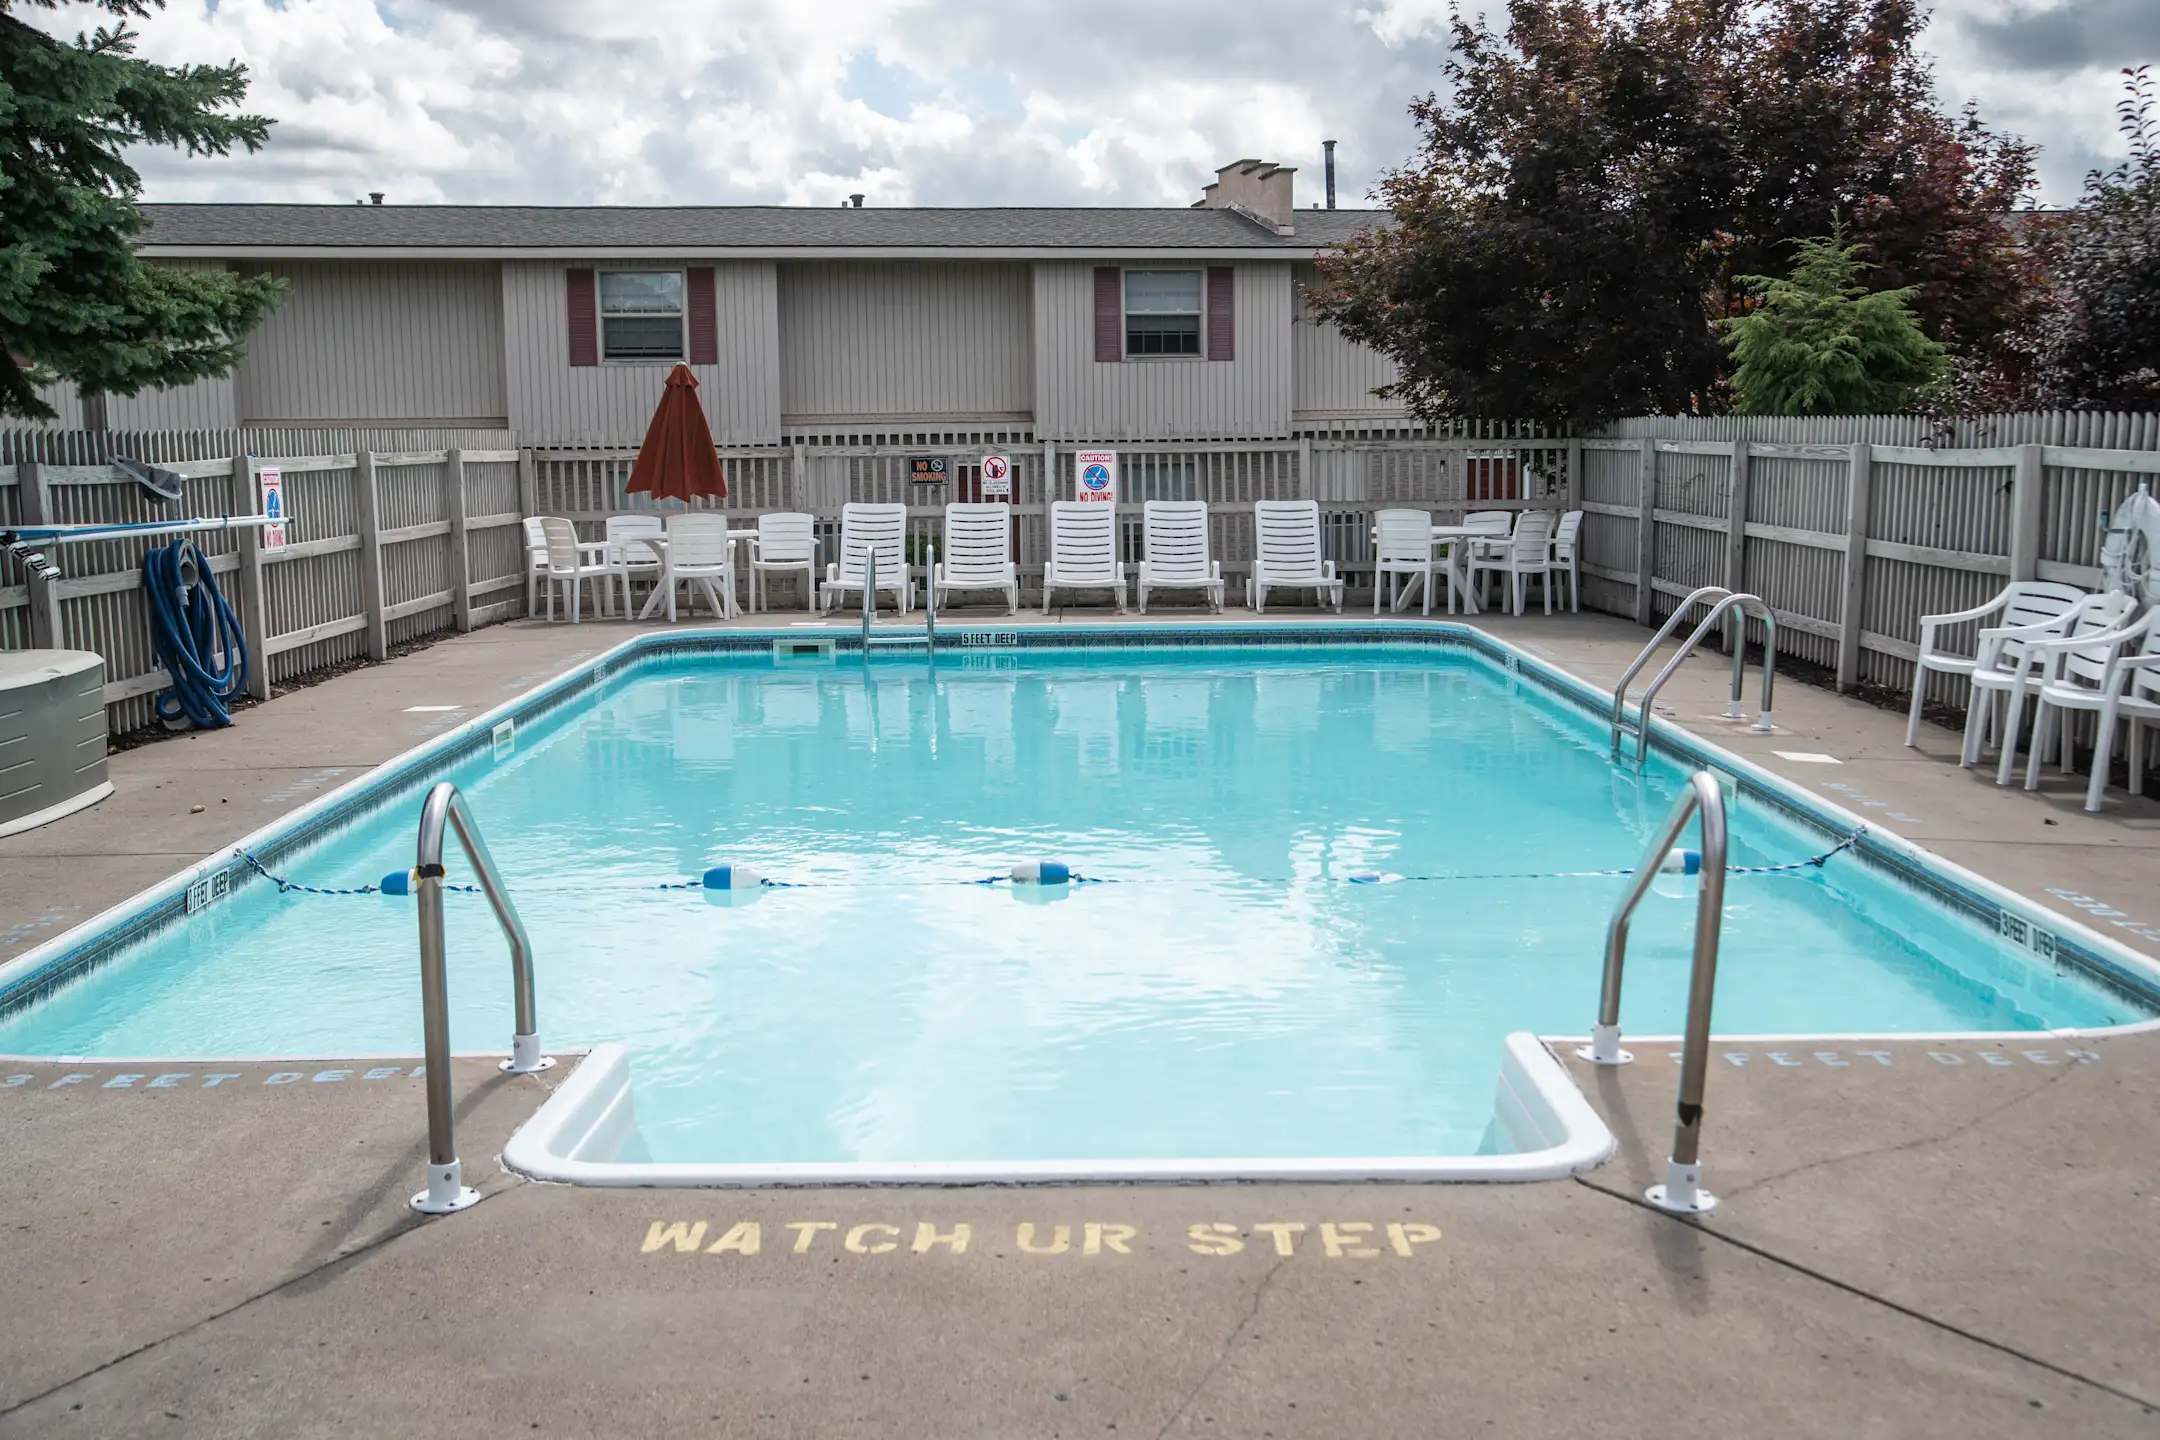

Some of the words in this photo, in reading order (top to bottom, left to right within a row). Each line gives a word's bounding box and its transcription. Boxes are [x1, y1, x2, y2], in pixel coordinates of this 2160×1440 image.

[1080, 454, 1112, 462] CAUTION!
[916, 461, 928, 471] NO
[911, 471, 947, 482] SMOKING
[1079, 491, 1089, 502] NO
[1090, 491, 1114, 502] DIVING!
[963, 633, 969, 644] 5
[970, 633, 992, 644] FEET
[995, 633, 1016, 644] DEEP
[211, 871, 228, 898] DEEP
[2002, 911, 2009, 937] 3
[1722, 1050, 1894, 1068] FEET
[1926, 1049, 2101, 1066] DEEP
[47, 1072, 243, 1090] FEET
[641, 1220, 972, 1255] WATCH
[1016, 1221, 1139, 1255] UR
[1187, 1221, 1442, 1257] STEP
